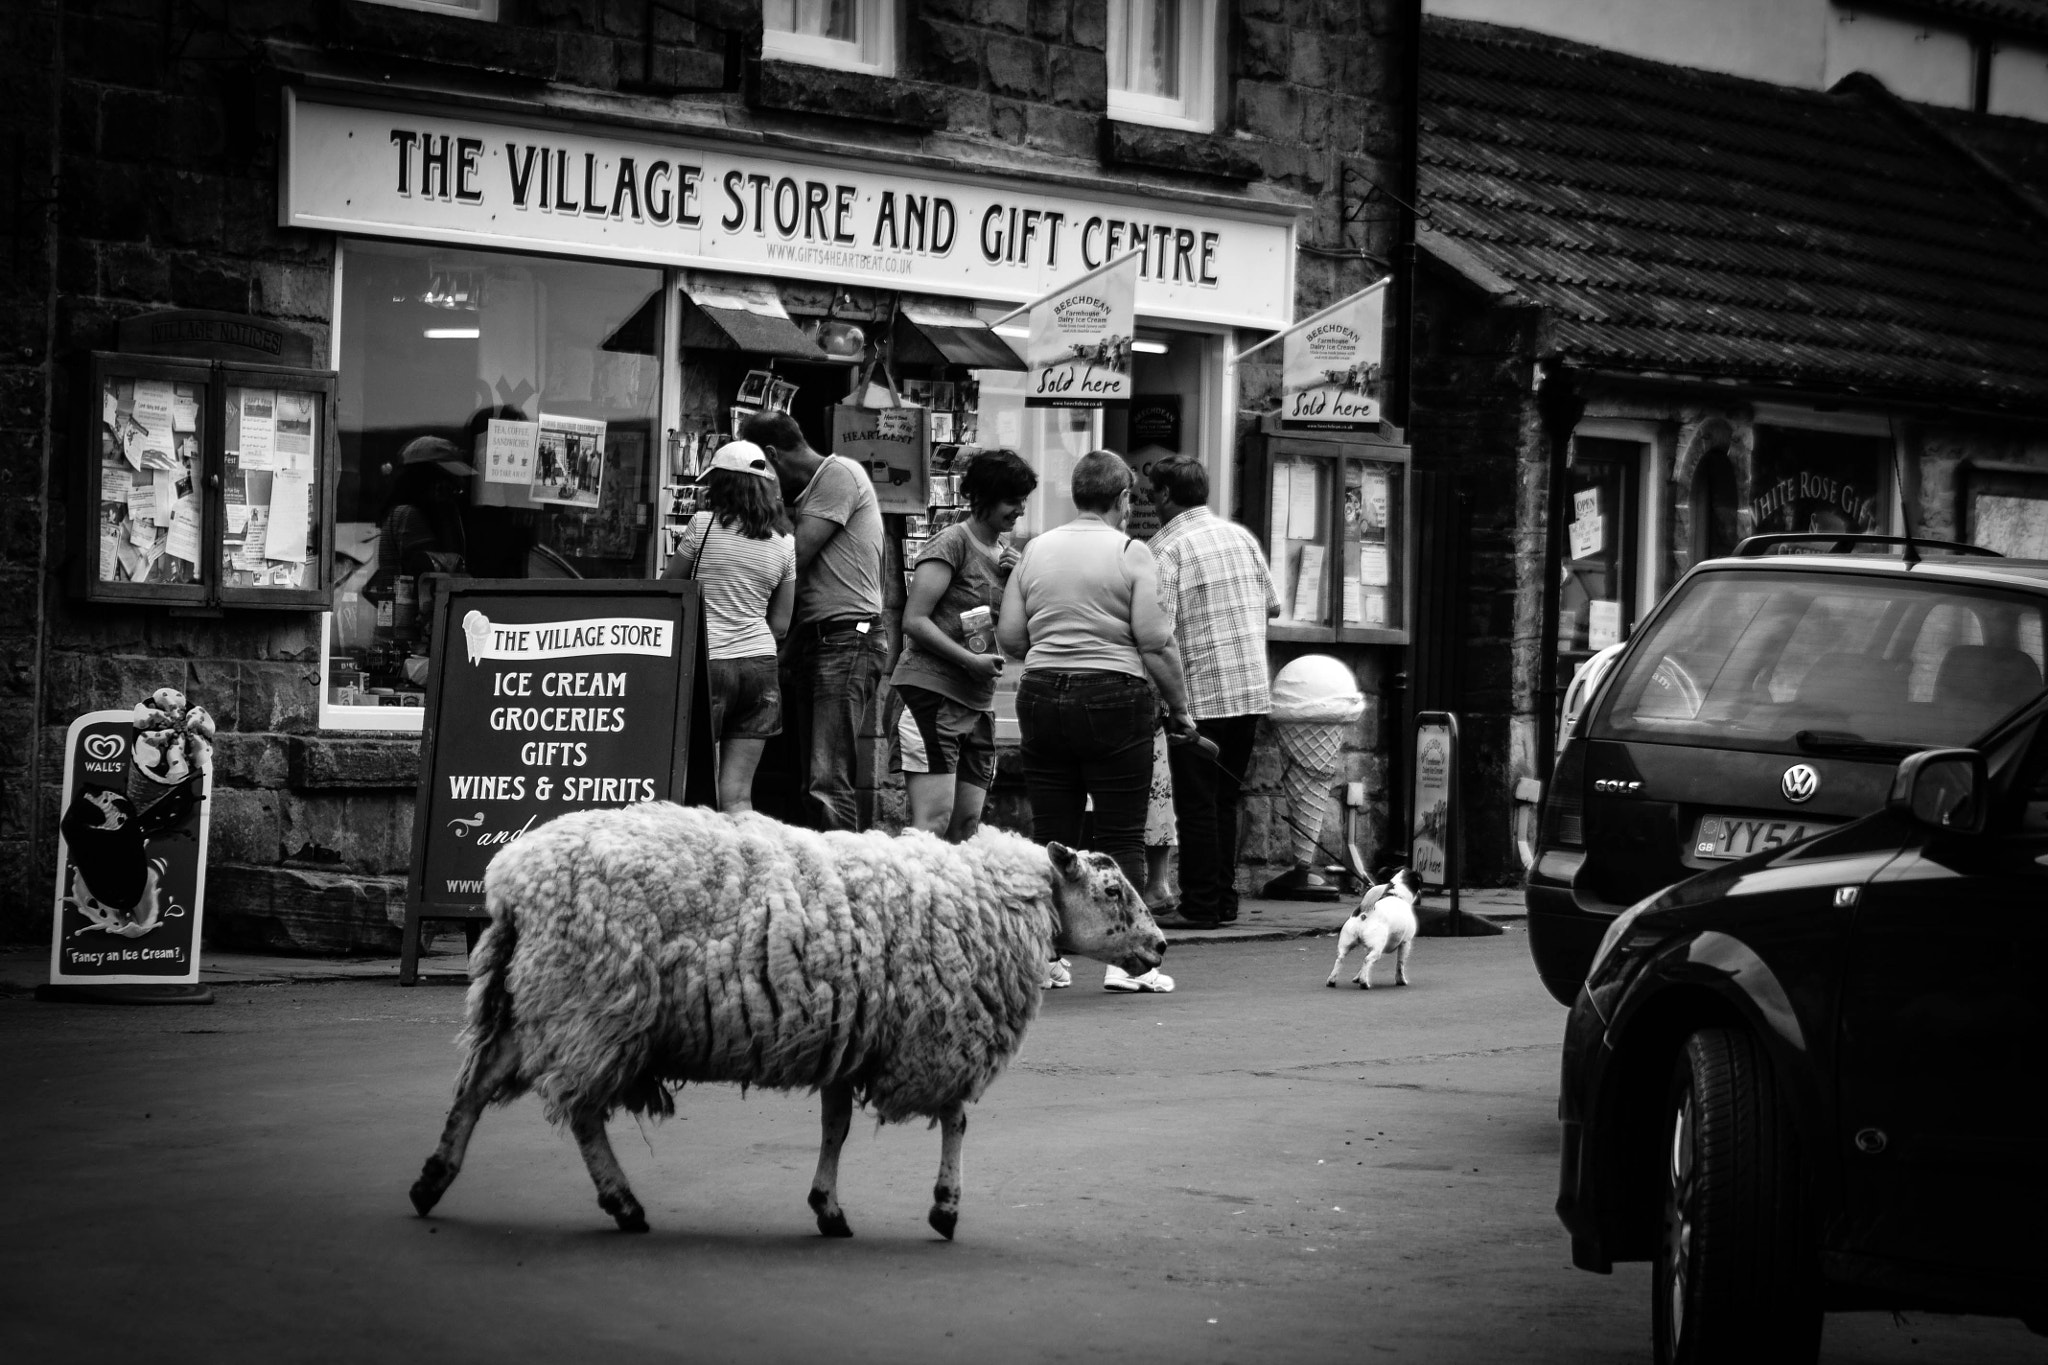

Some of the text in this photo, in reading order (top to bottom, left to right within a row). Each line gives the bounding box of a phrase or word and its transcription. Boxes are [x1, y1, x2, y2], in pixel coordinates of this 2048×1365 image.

[390, 129, 1220, 287] THE VILLAGE STORE AND GIFT CENTRE
[767, 243, 912, 274] WWW.GIFTS4HEARTBEAT.CO.UK
[1053, 295, 1112, 315] BEECHDEAN
[1057, 316, 1074, 324] Dairy
[154, 320, 279, 352] VILLAGE NOTICES
[1305, 324, 1361, 343] BEECHDEAN
[1309, 343, 1325, 351] Dairy
[1036, 366, 1122, 394] Sold here
[1292, 391, 1370, 417] Sold here
[1800, 471, 1838, 504] ROSE
[1576, 498, 1595, 513] OPEN
[494, 624, 663, 651] THE VILLAGE STORE
[493, 672, 627, 697] ICE CREAM
[490, 707, 625, 732] GROCERIES
[84, 761, 122, 772] WALL'S
[521, 742, 587, 766] GIFTS
[449, 776, 655, 802] WINES & SPIRITS
[1593, 779, 1641, 793] GOLF
[477, 814, 537, 846] and
[1698, 842, 1714, 852] GB
[72, 947, 180, 966] Fancy an Ice Cream?
